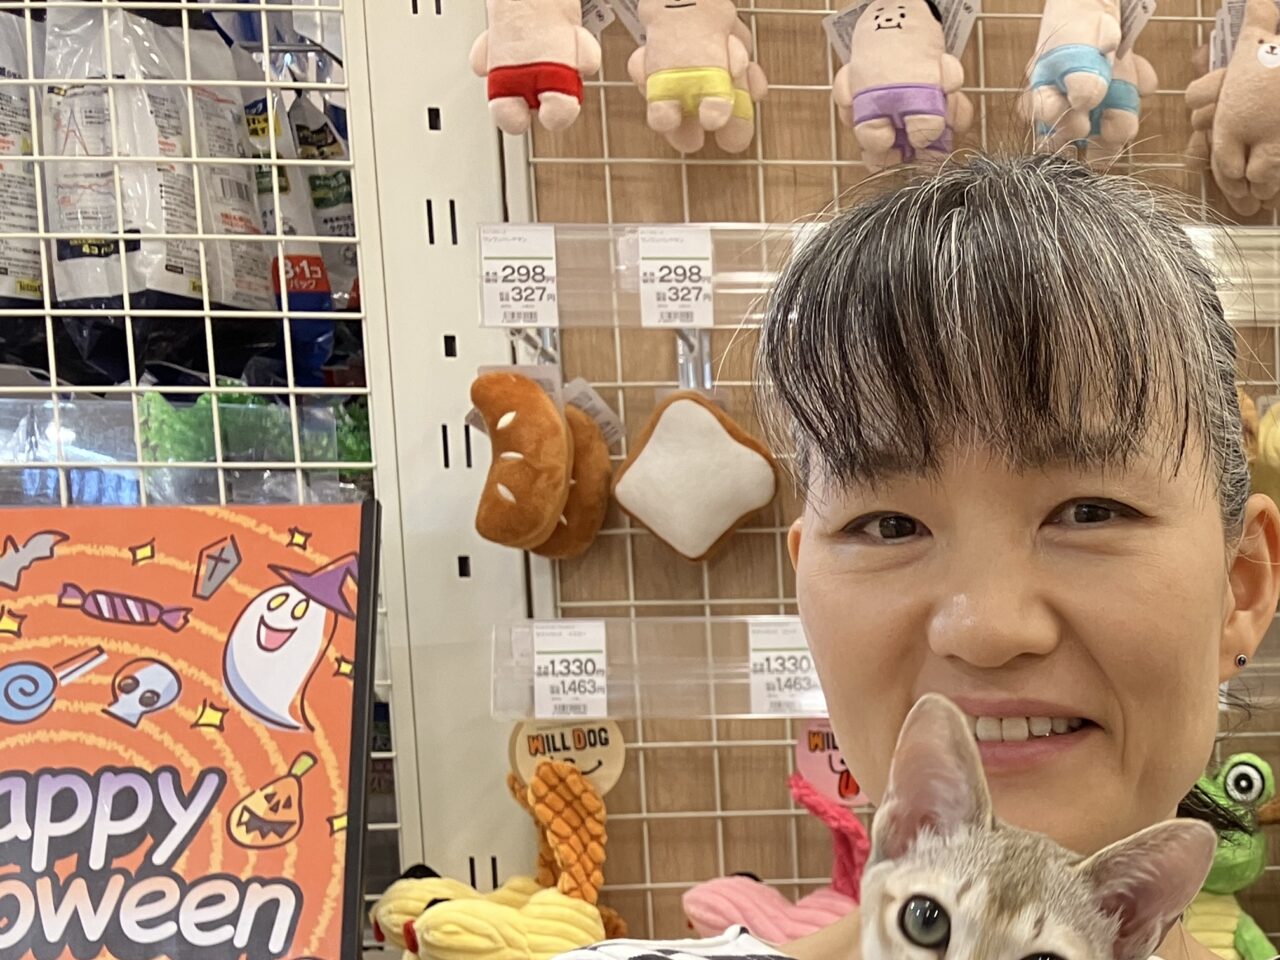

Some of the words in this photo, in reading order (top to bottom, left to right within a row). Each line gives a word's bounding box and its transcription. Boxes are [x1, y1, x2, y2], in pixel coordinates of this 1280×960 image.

[527, 733, 571, 756] WILL
[572, 728, 610, 750] DOG
[808, 729, 839, 752] WIL
